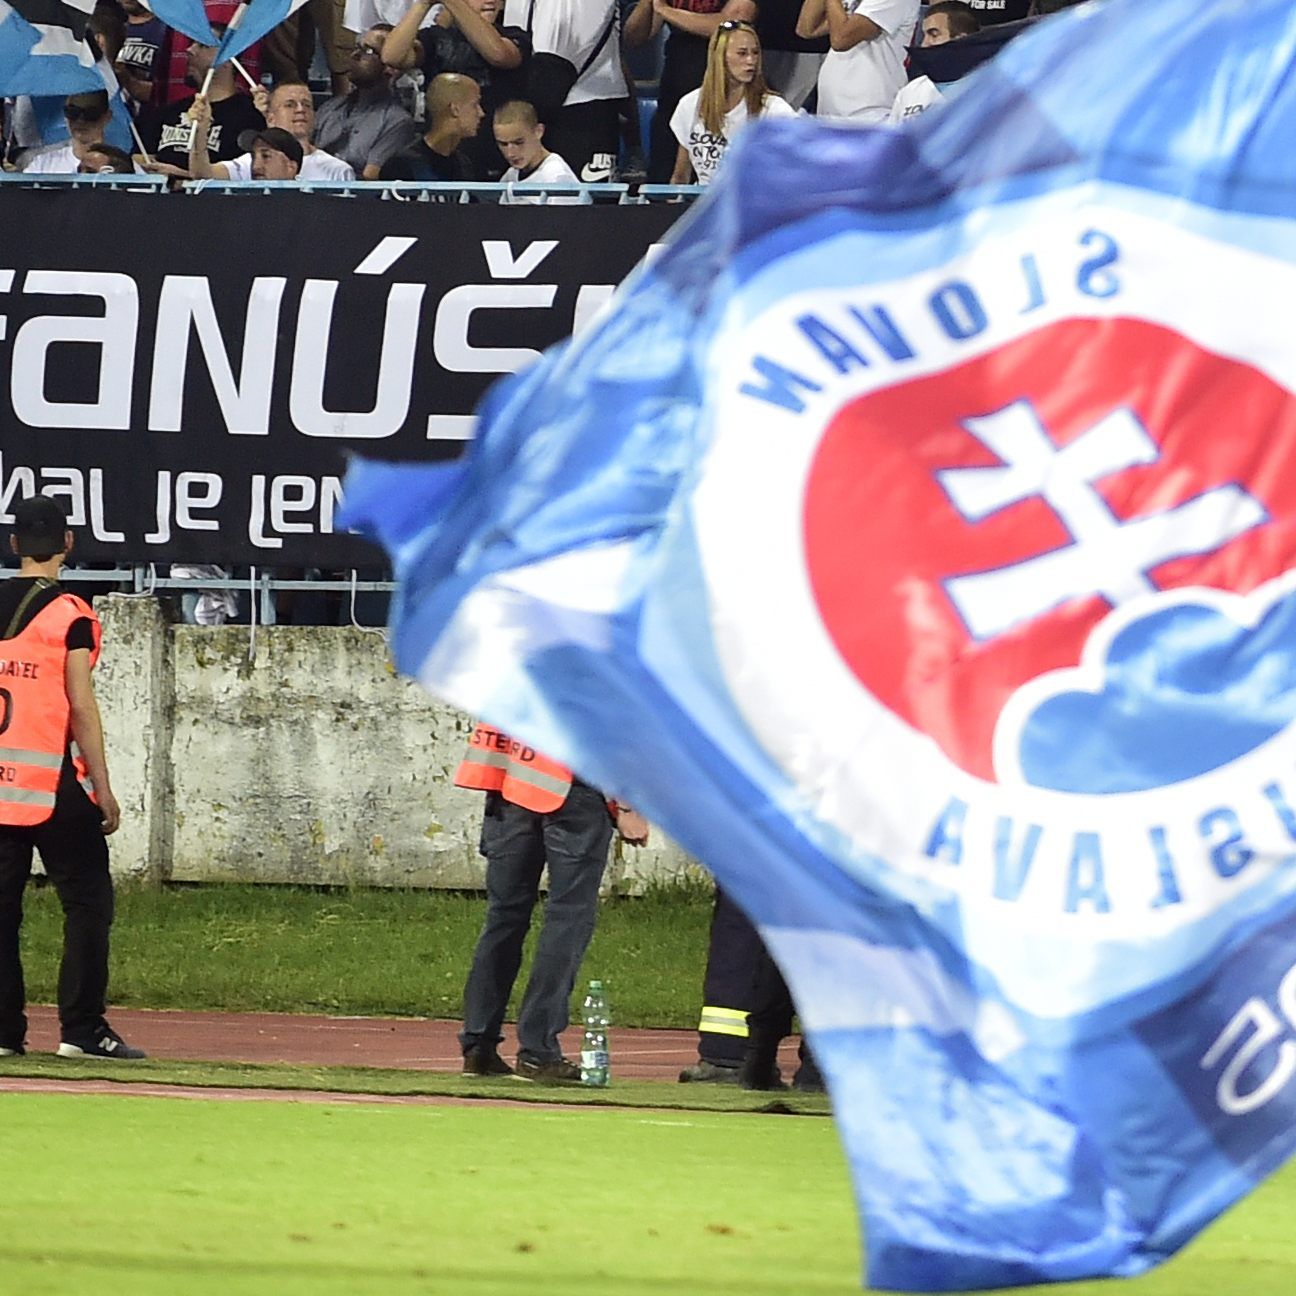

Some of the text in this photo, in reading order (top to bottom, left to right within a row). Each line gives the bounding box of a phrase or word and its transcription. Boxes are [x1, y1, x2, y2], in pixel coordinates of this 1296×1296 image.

[158, 122, 223, 152] LONSE
[688, 131, 729, 148] SLOVA
[0, 236, 620, 440] aNÚŠ
[145, 470, 223, 543] je
